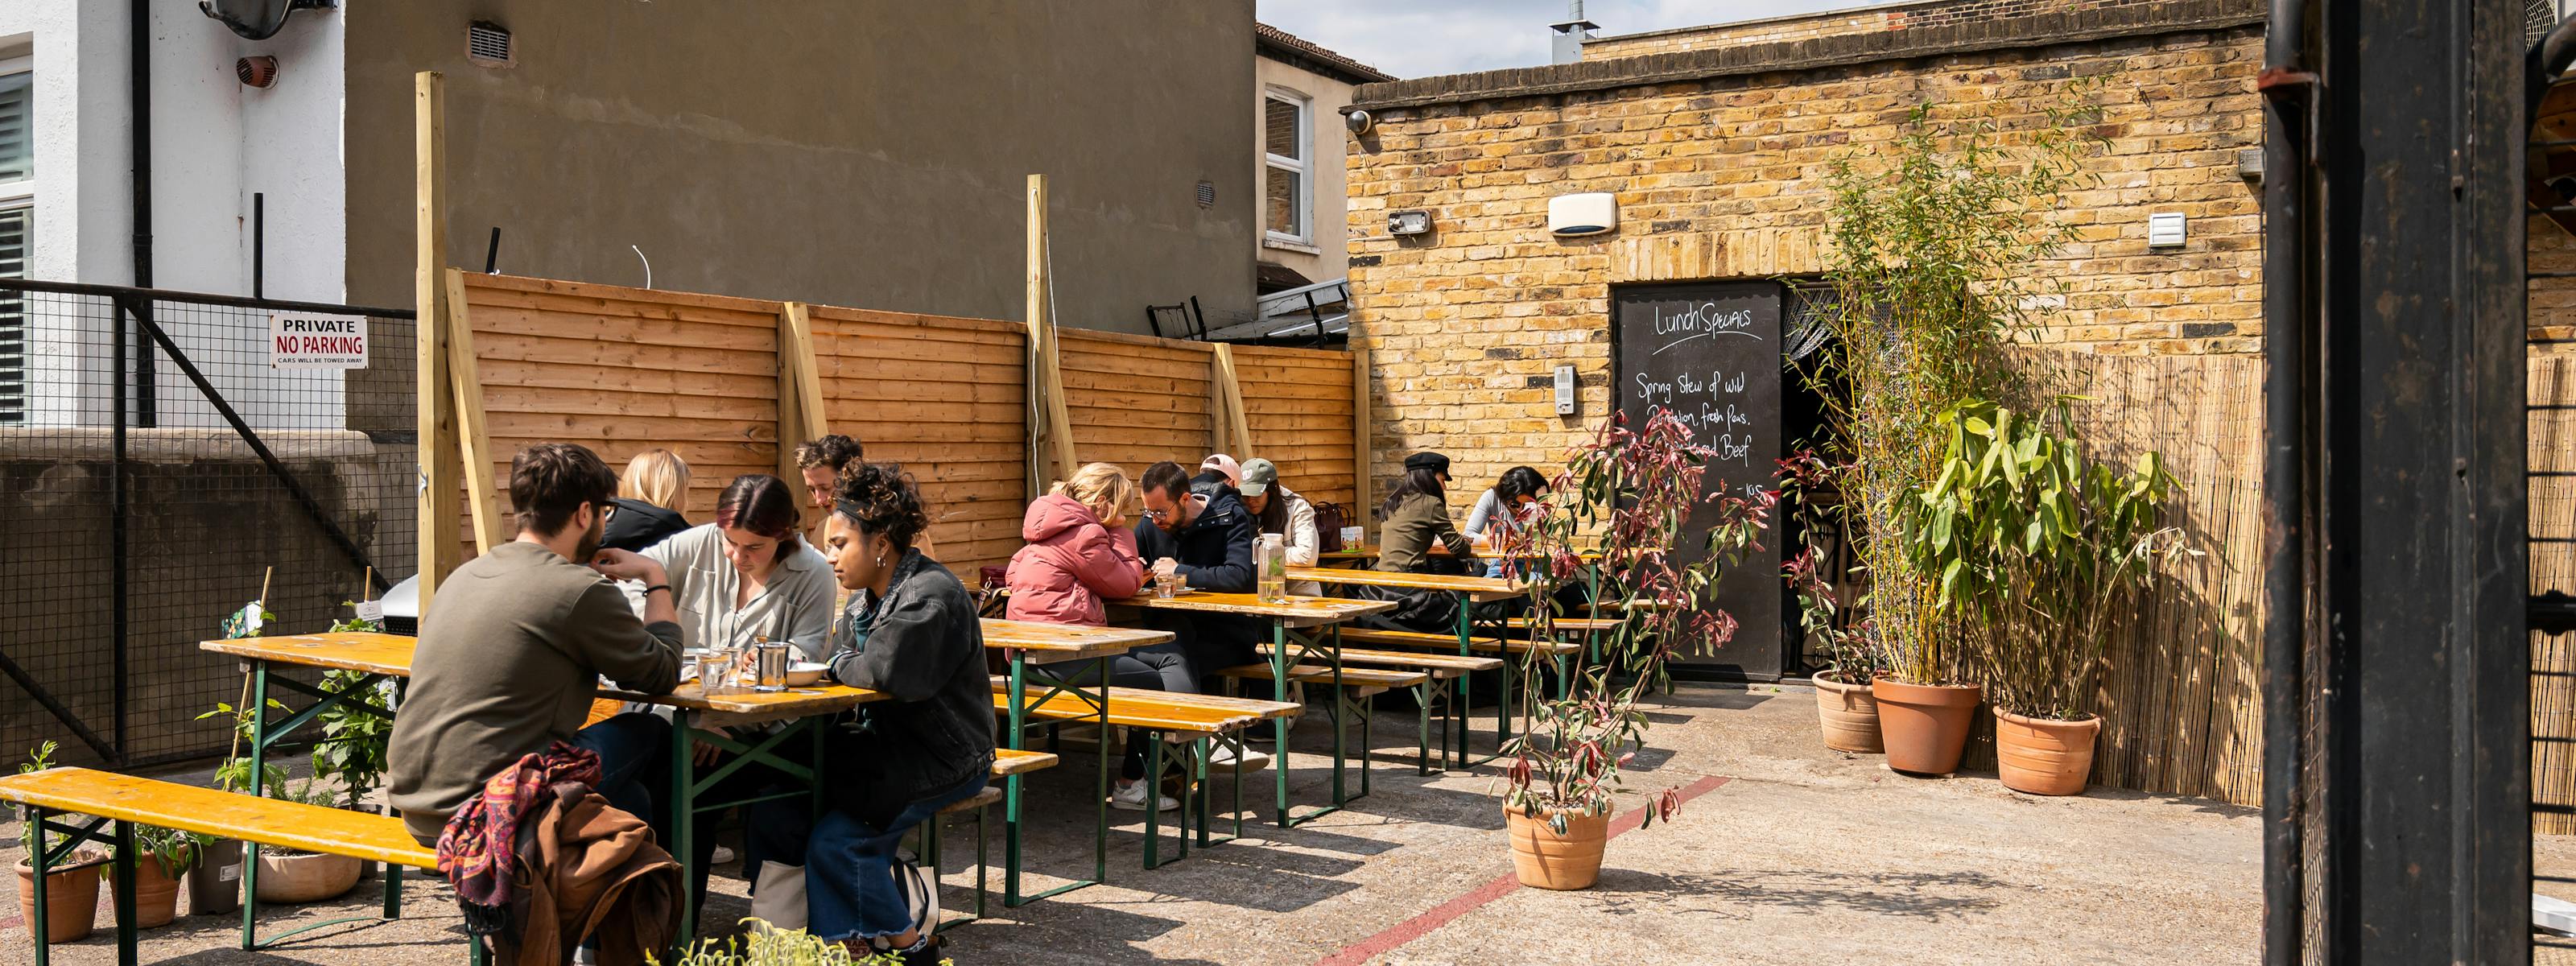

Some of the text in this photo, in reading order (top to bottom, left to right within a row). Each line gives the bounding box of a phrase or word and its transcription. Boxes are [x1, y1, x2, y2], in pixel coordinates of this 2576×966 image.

[283, 320, 356, 332] PRIVATE
[1655, 302, 1700, 335] Lunch
[276, 336, 362, 354] NO PARKING
[1636, 372, 1672, 404] Spring
[1677, 371, 1703, 394] Stew
[1725, 371, 1744, 394] wild
[1719, 433, 1752, 469] Beef
